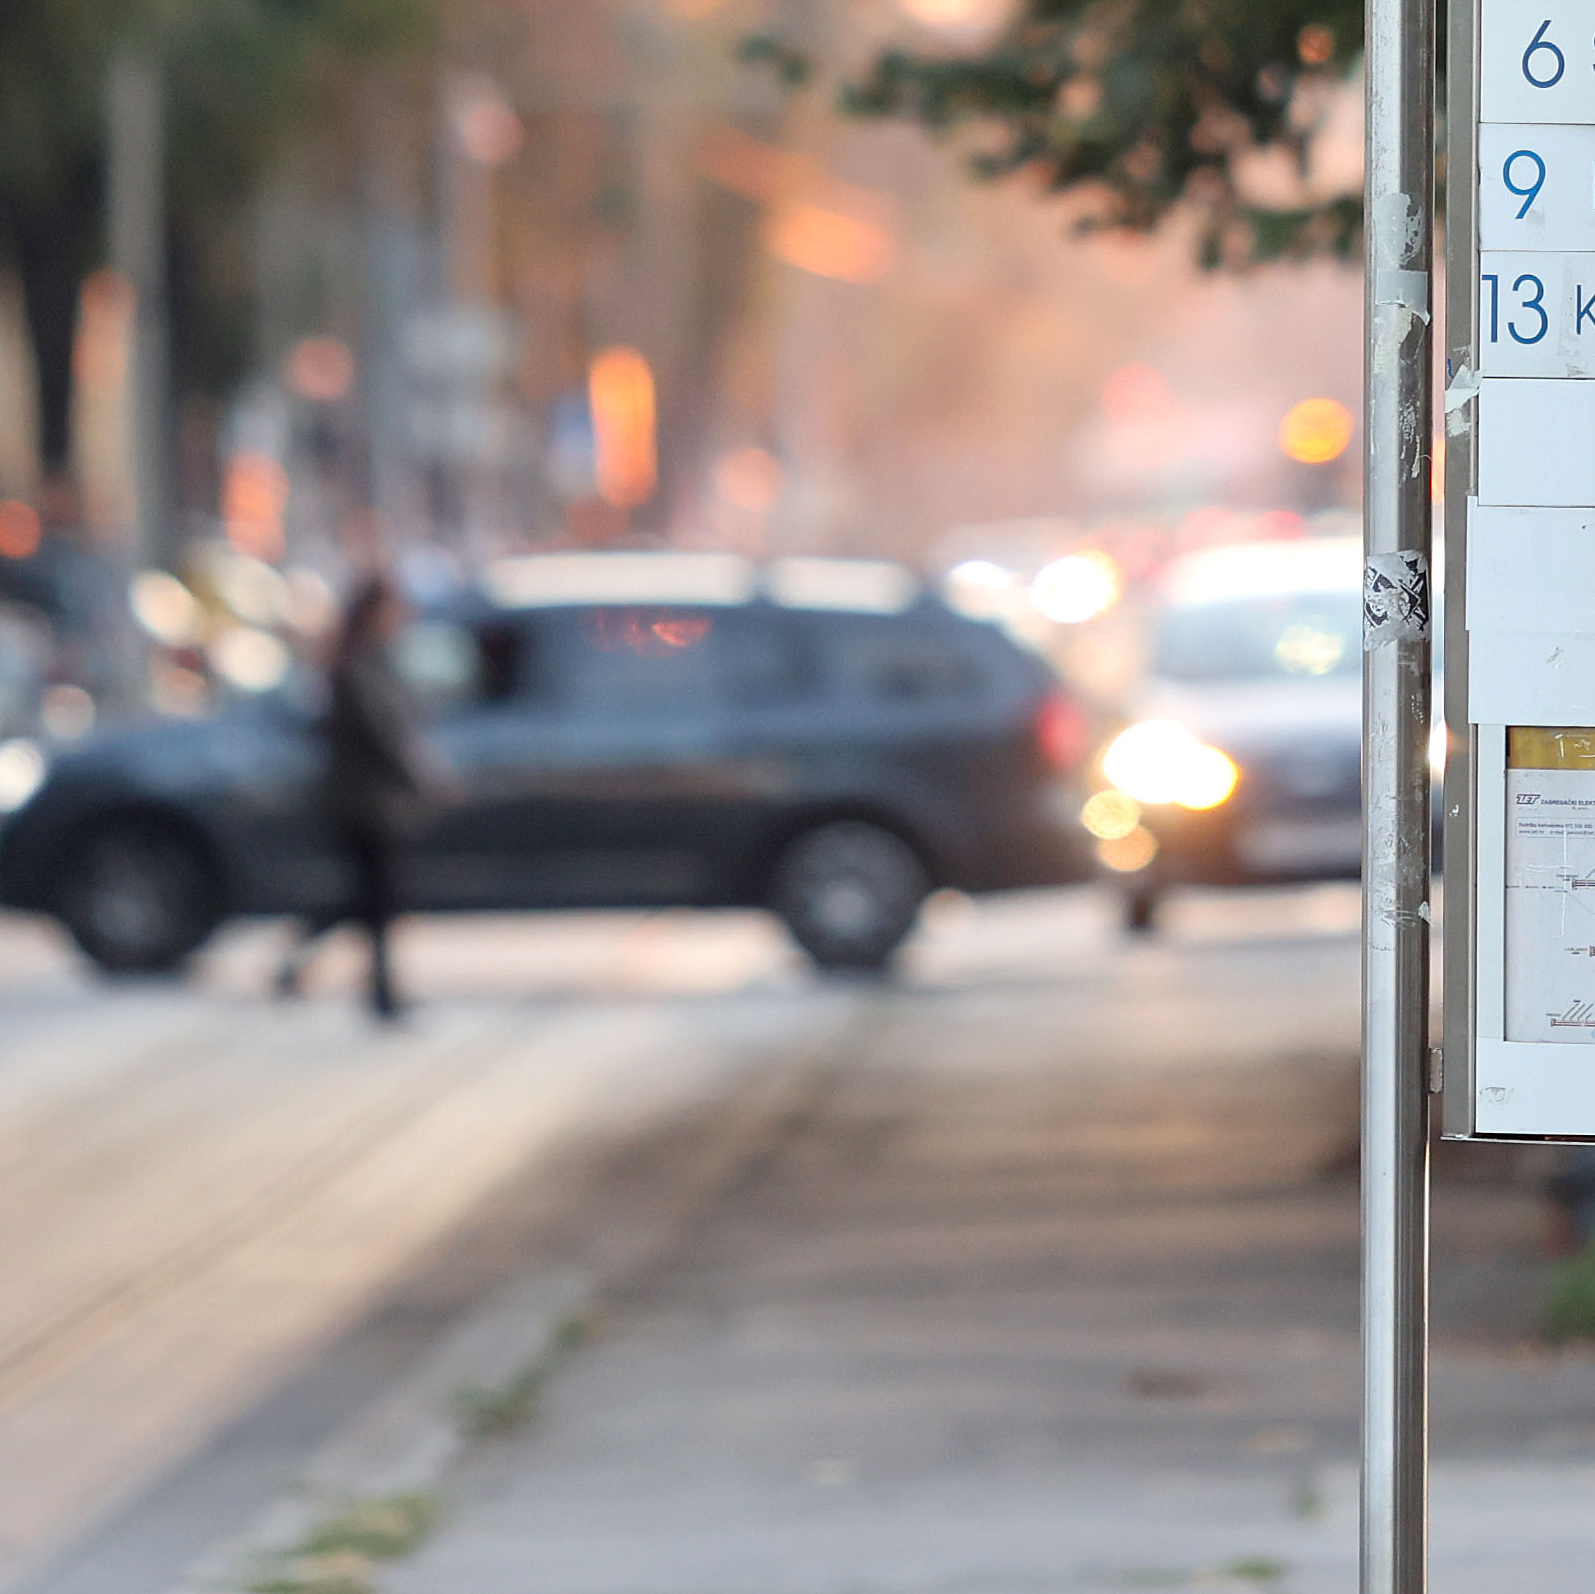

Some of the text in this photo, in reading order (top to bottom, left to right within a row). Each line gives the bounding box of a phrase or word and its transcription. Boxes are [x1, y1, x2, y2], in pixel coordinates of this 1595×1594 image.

[1522, 20, 1565, 88] 6
[1503, 150, 1546, 219] 9
[1482, 274, 1548, 345] 13
